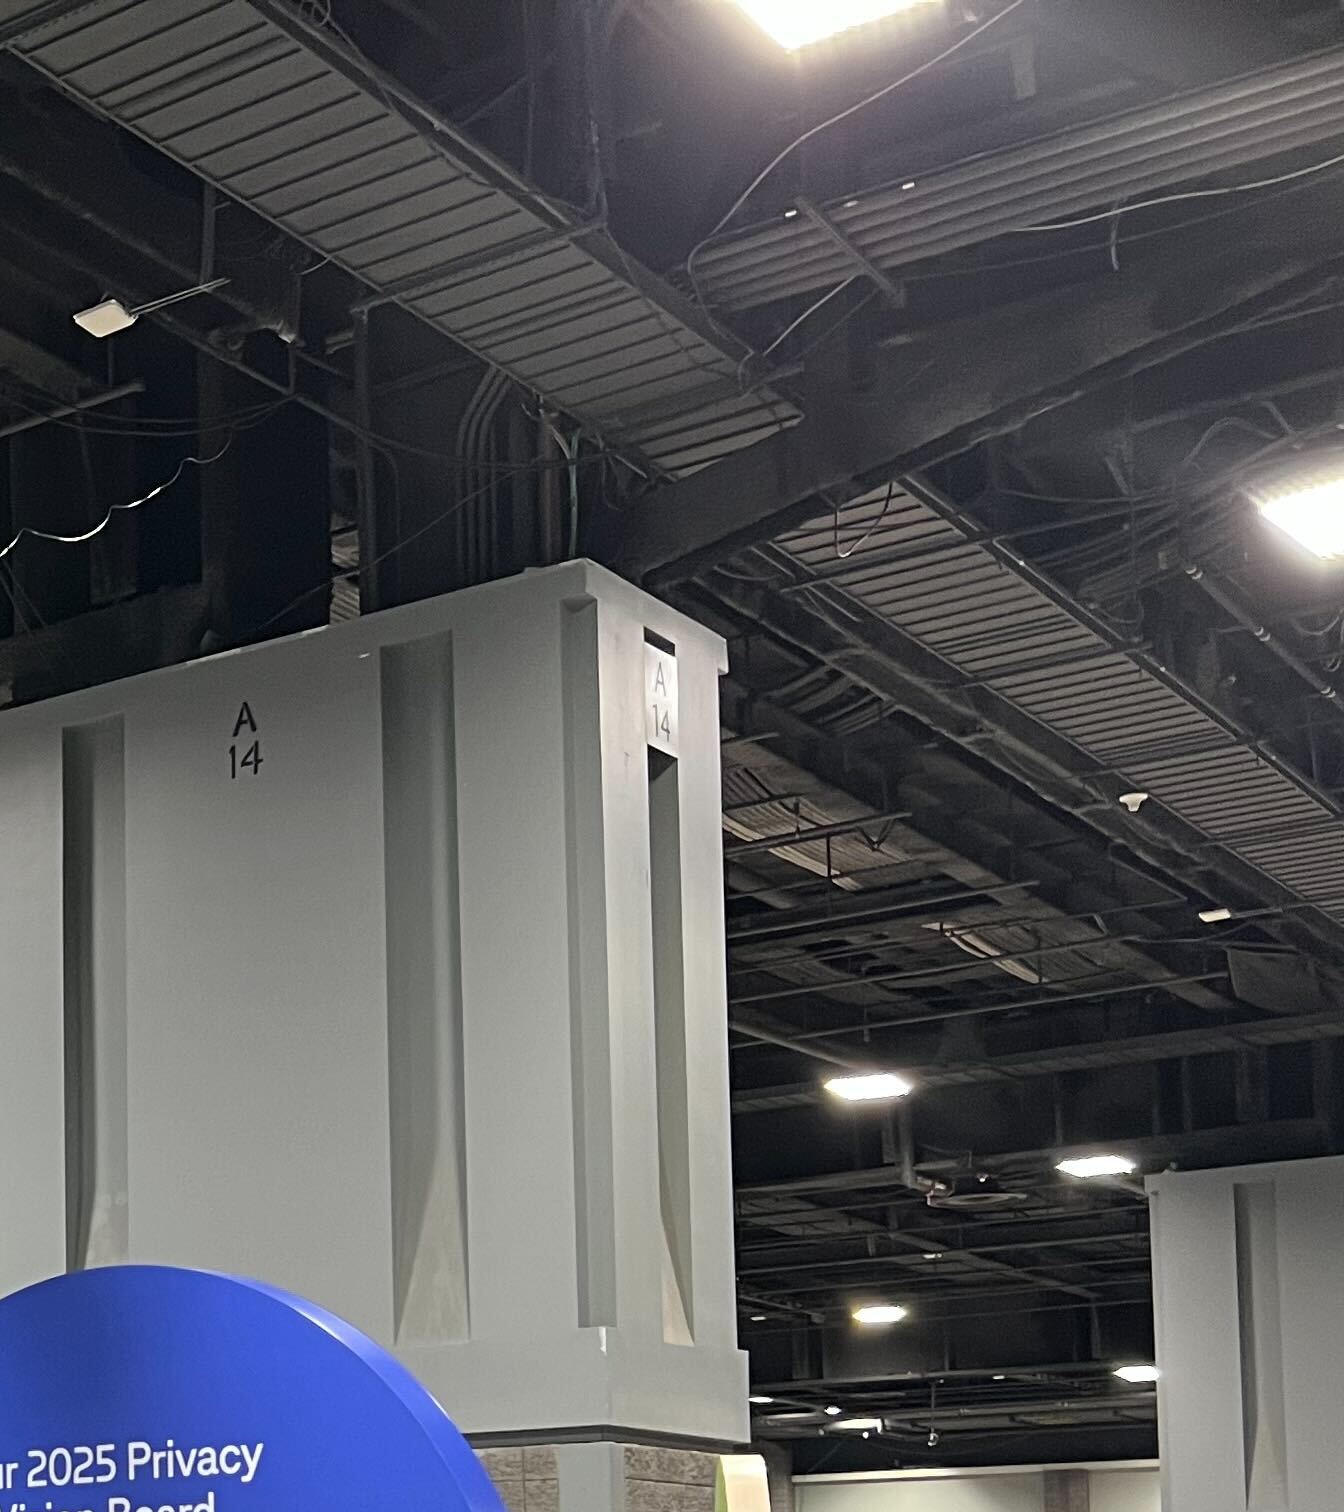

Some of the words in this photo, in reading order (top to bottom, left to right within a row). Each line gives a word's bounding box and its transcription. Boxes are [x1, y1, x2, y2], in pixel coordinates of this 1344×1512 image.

[654, 660, 667, 697] A
[231, 701, 258, 737] A
[652, 703, 671, 743] 14
[228, 740, 264, 779] 14
[26, 1443, 117, 1488] 2025
[127, 1439, 264, 1484] Privacy
